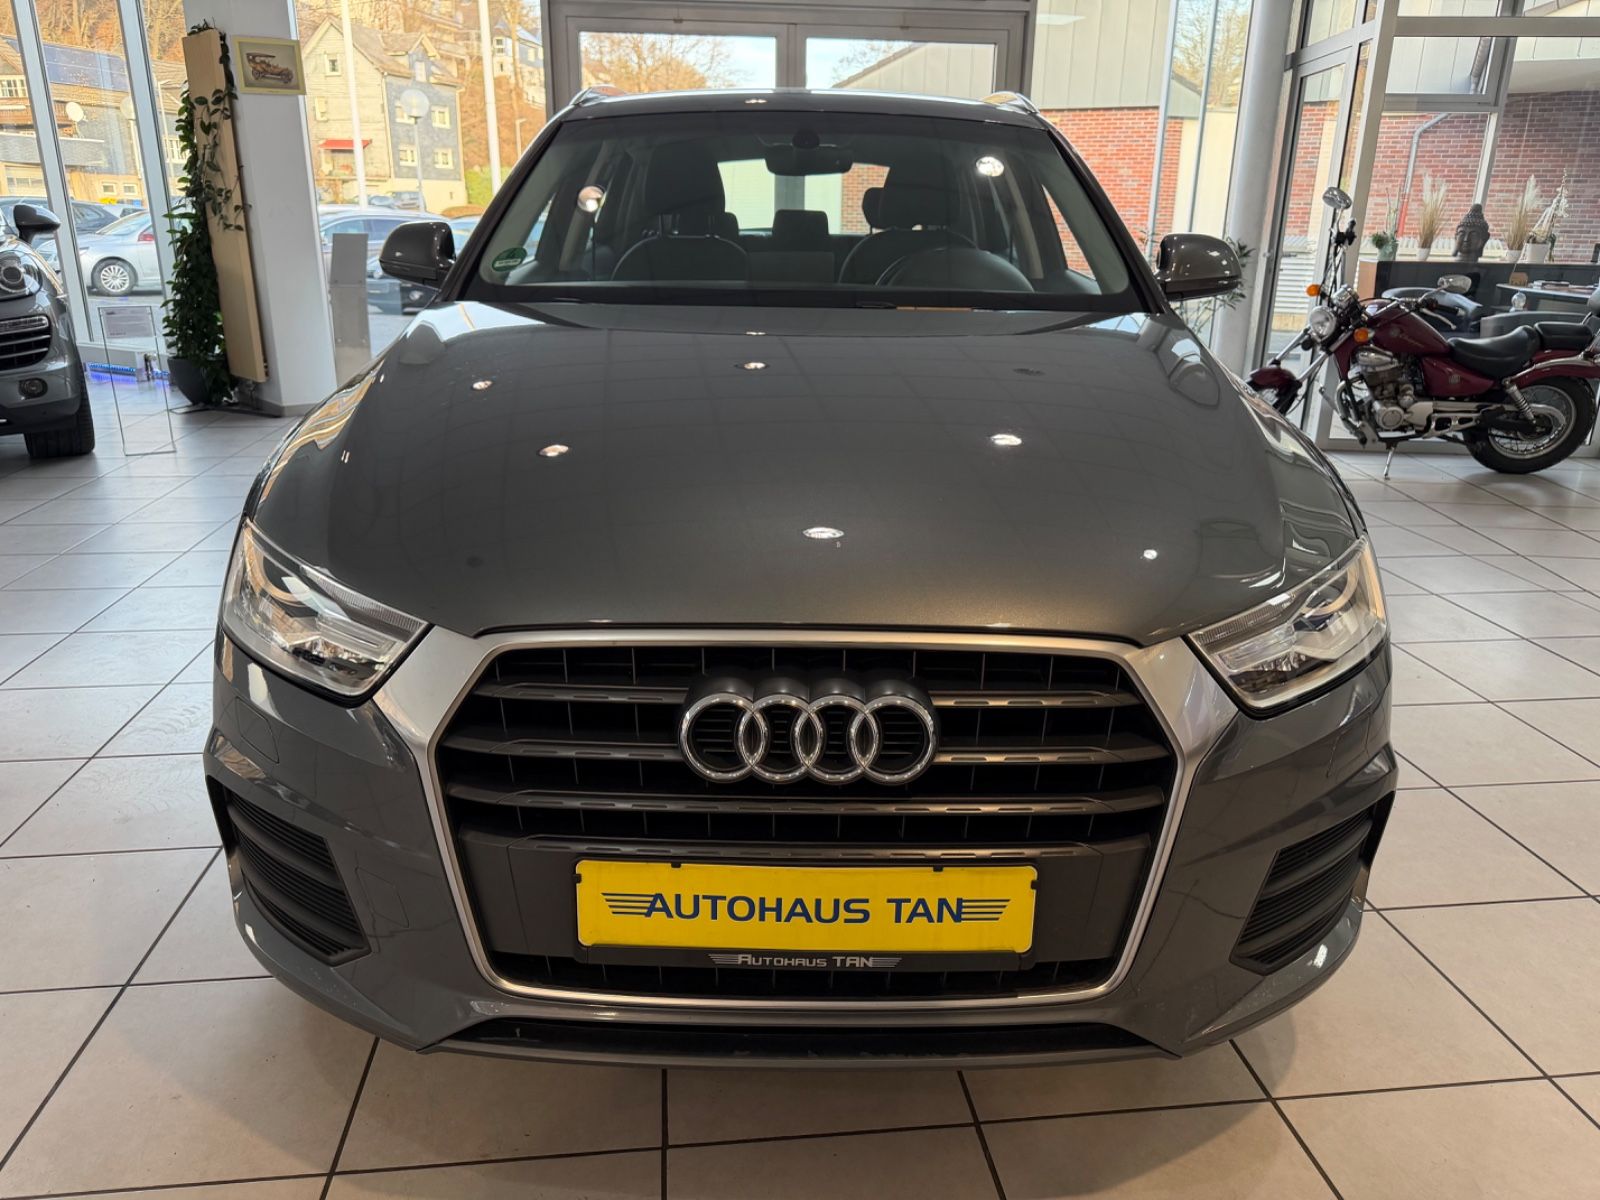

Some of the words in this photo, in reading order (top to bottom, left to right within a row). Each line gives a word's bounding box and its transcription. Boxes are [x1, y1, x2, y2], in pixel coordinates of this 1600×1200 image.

[645, 893, 870, 923] AUTOHAUS
[887, 898, 963, 923] TAN
[833, 956, 873, 968] TAN
